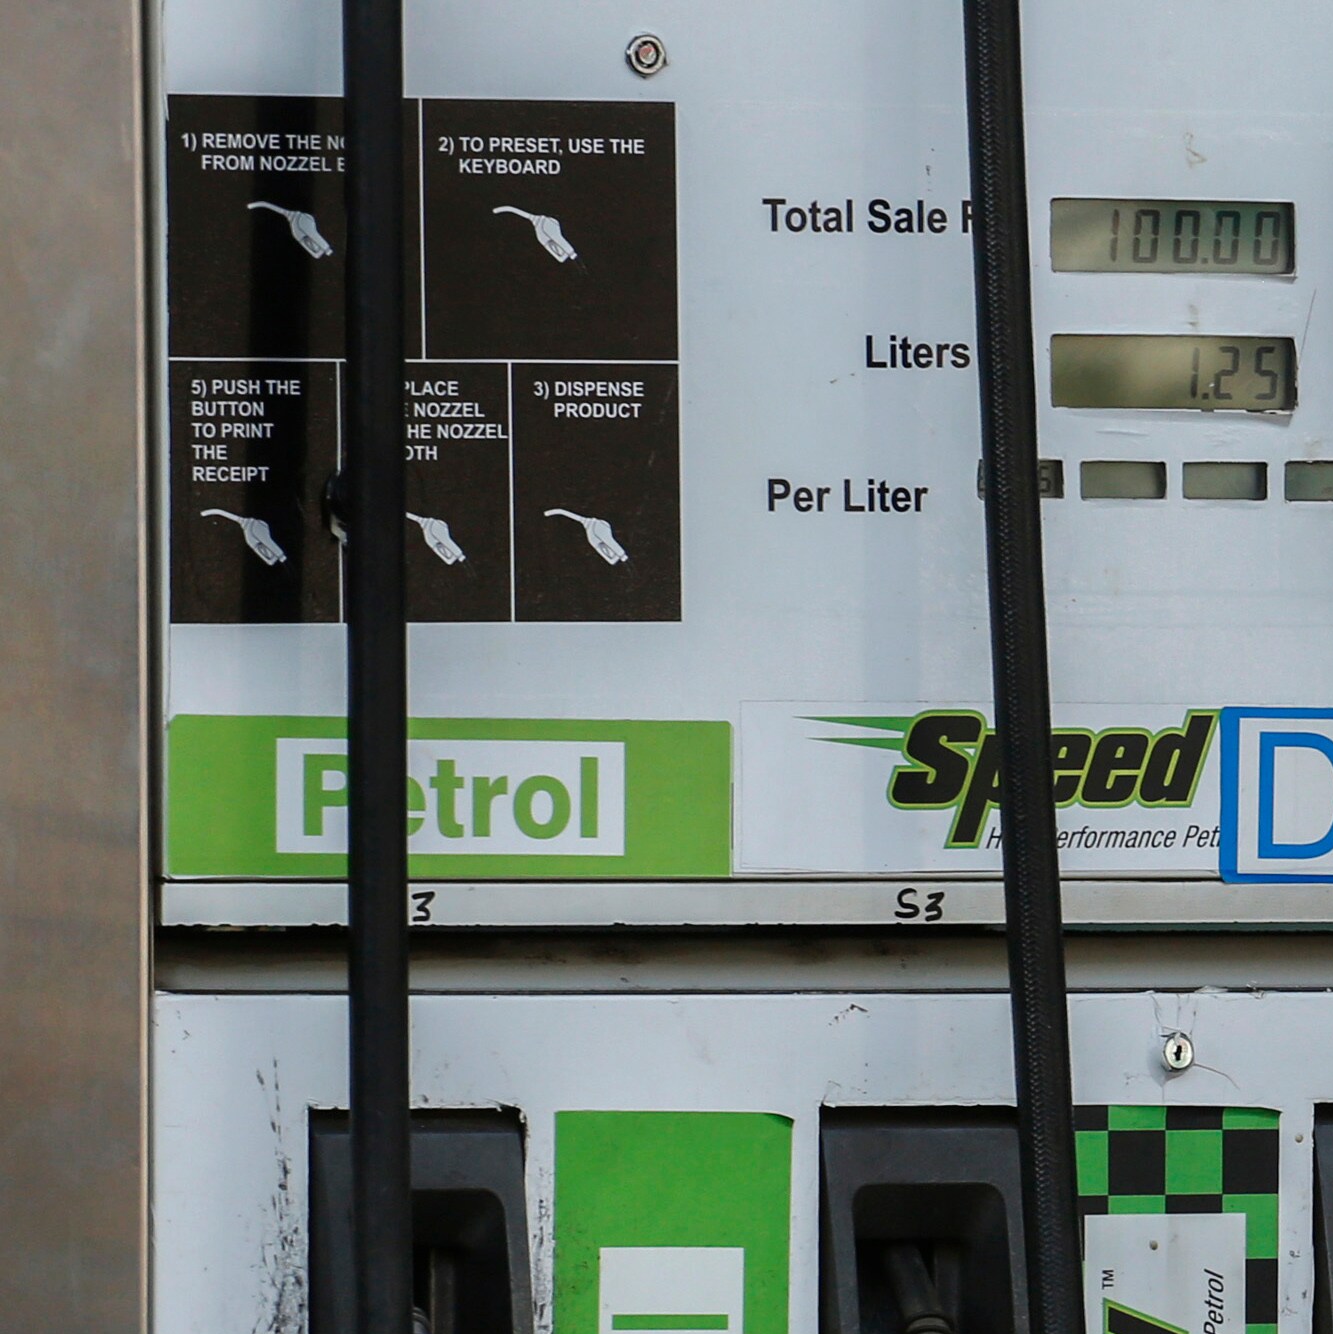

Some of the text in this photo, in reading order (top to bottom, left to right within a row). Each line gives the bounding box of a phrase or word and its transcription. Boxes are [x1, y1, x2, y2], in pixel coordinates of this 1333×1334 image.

[182, 133, 196, 151] 1)
[203, 133, 279, 149] REMOVE
[286, 135, 320, 149] THE
[439, 137, 644, 155] 2) TO PRESET, USE THE
[202, 155, 254, 170] FROM
[261, 156, 331, 171] NOZZEL
[460, 159, 560, 174] KEYBOARD
[763, 199, 852, 232] Total
[868, 199, 947, 233] Sale
[1110, 208, 1282, 265] 100.00
[866, 335, 970, 368] Liters
[1189, 346, 1280, 401] 1.25
[192, 380, 300, 398] 5) PUSH THE
[534, 382, 644, 399] 3) DISPENSE
[192, 401, 263, 416] BUTTON
[414, 403, 485, 417] NOZZEL
[555, 403, 641, 418] PRODUCT
[192, 423, 273, 438] TO PRINT
[407, 424, 508, 439] HE NOZZEL
[192, 445, 227, 459] THE
[193, 467, 269, 481] RECEIPT
[768, 479, 928, 512] Per Liter
[1056, 825, 1176, 849] erformance
[411, 891, 436, 922] 3
[894, 888, 945, 922] S3
